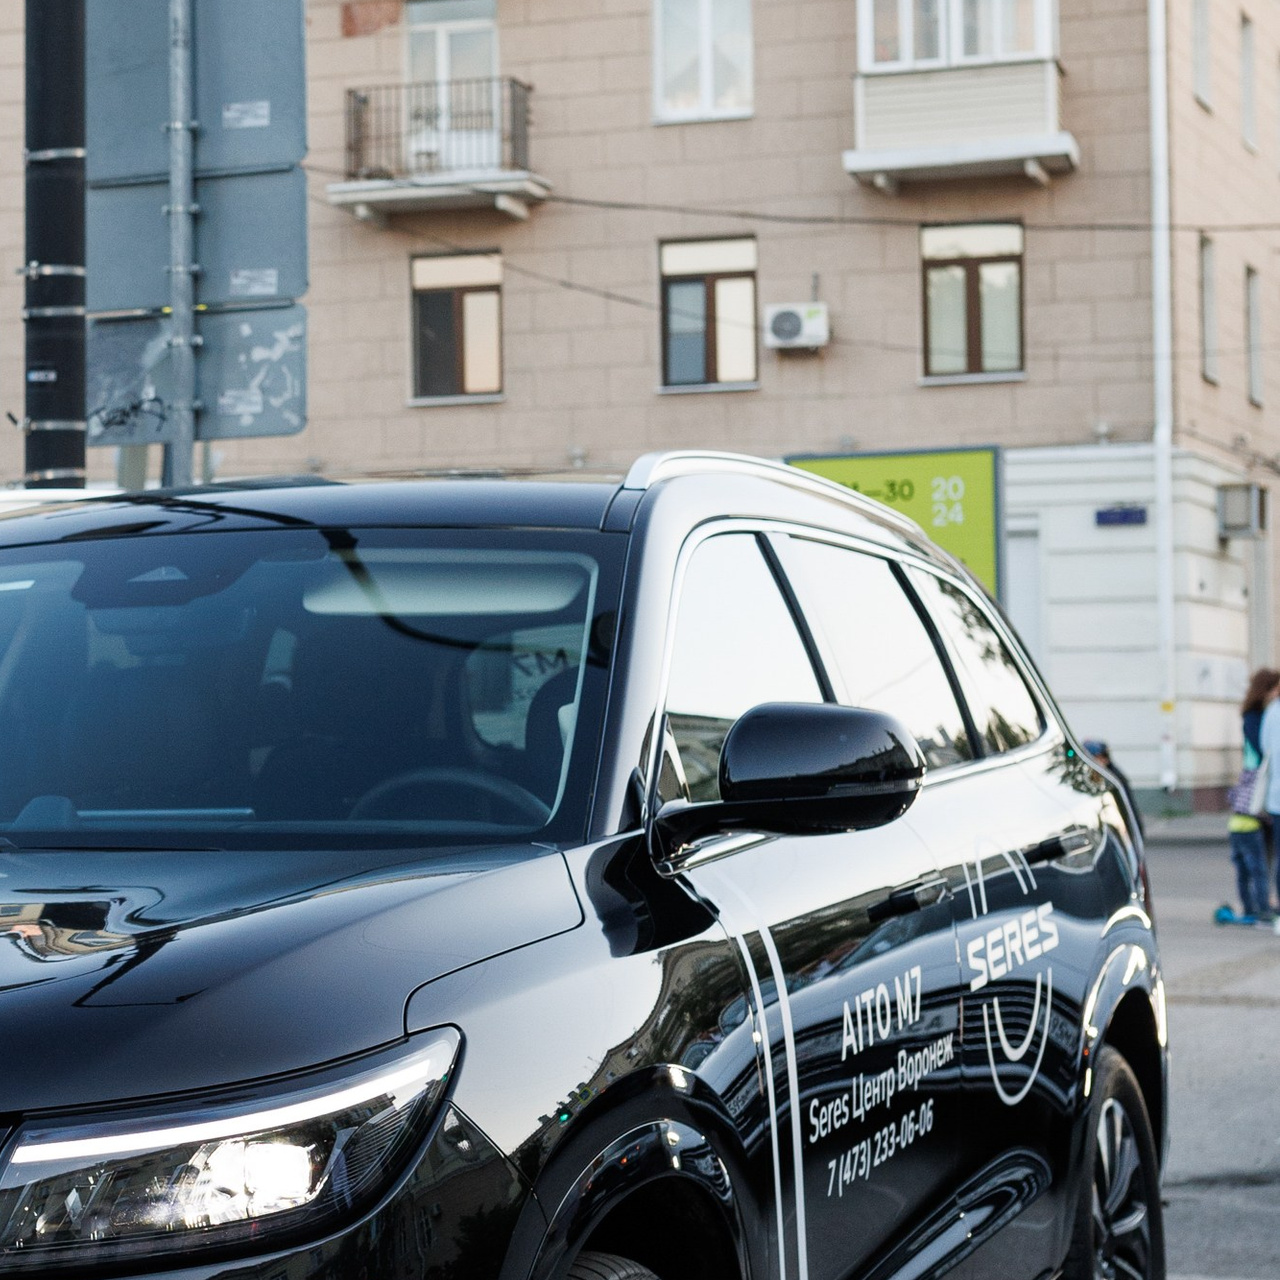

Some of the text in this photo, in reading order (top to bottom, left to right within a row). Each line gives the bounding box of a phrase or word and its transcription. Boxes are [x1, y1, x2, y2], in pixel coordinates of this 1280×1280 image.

[930, 474, 966, 501] 20
[931, 501, 965, 528] 24
[967, 900, 1060, 993] SERES
[840, 965, 922, 1062] AITO M7
[809, 1032, 955, 1144] Seres Центр Воронеж
[838, 1136, 872, 1198] (473)
[873, 1097, 935, 1167] 233-06-06
